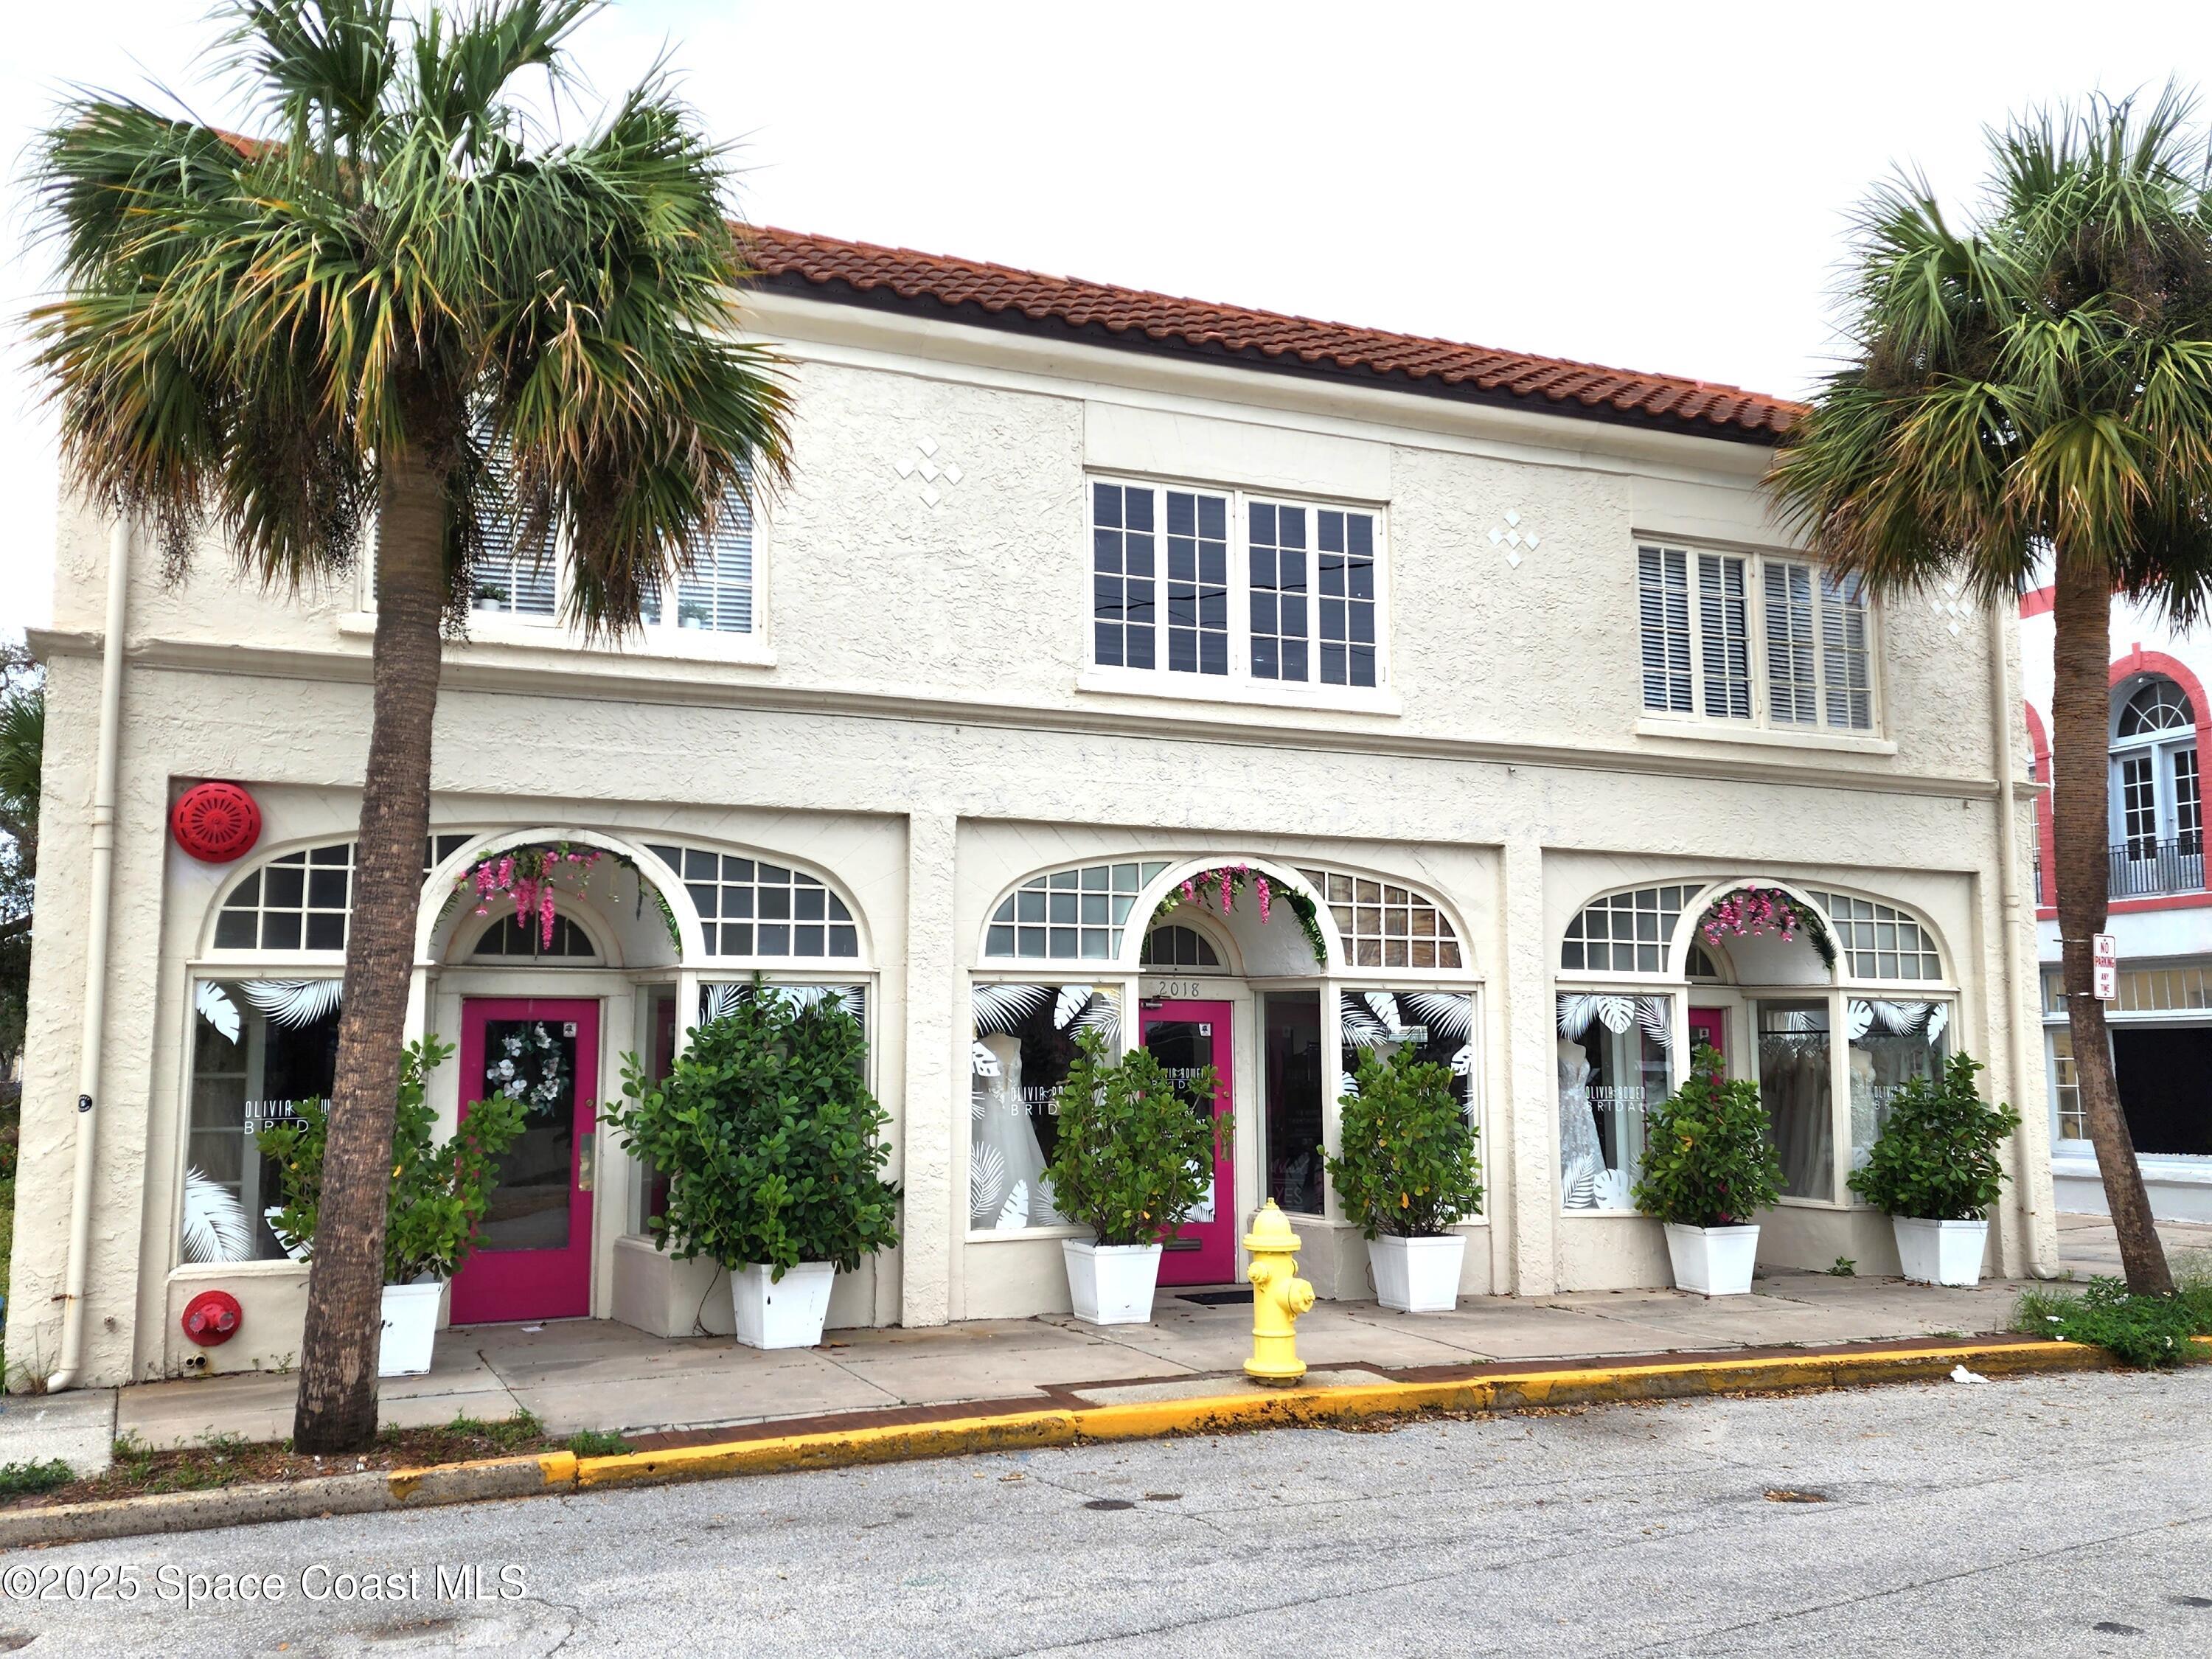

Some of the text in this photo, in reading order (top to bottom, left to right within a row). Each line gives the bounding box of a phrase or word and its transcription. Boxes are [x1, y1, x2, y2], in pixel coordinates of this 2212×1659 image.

[2101, 942, 2109, 953] NO
[2095, 956, 2115, 968] PARKING
[1159, 981, 1200, 997] 2018
[2100, 984, 2110, 992] TIME
[1011, 1086, 1045, 1102] OLIVIA
[1585, 1085, 1646, 1099] OLIVIA BOWEN
[245, 1099, 291, 1118] OLIVIA
[1011, 1103, 1057, 1116] BRID
[1586, 1101, 1645, 1113] BRIDAL
